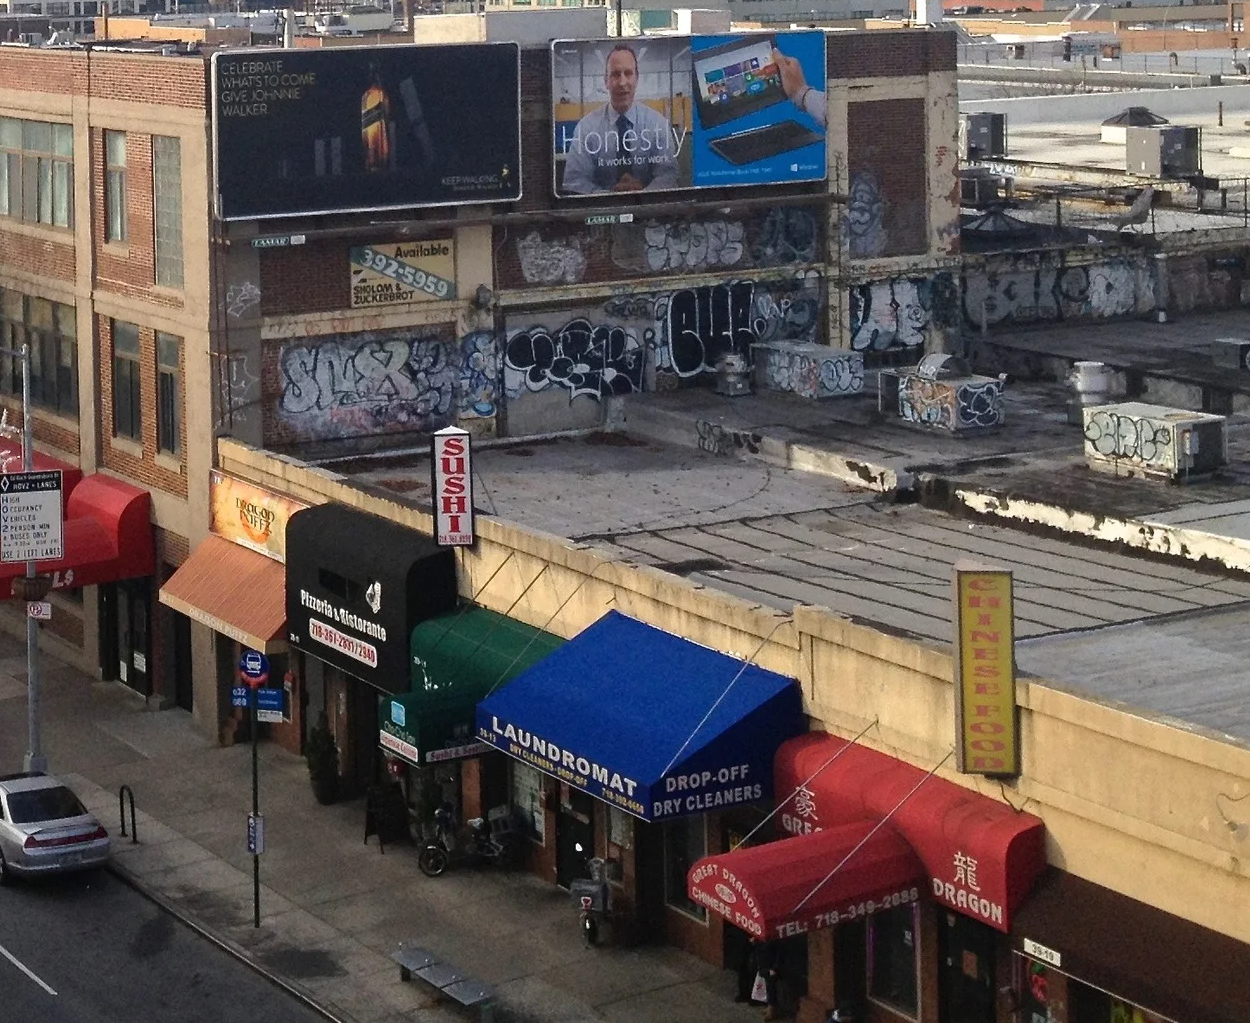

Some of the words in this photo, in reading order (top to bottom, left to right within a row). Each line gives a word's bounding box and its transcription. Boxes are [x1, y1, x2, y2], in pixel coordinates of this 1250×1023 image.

[220, 60, 284, 75] CELEBRATE
[264, 75, 279, 87] TO
[281, 72, 316, 86] COME
[221, 90, 248, 103] GIVE
[250, 87, 301, 101] JOHNNIE
[221, 103, 268, 117] WALKER
[562, 119, 688, 158] Honestly
[597, 157, 605, 167] it
[606, 156, 632, 167] works
[633, 155, 646, 165] for
[587, 215, 615, 224] LAMAR
[394, 243, 450, 258] Available
[359, 249, 448, 297] 392-5959
[353, 283, 393, 295] SHOLOM
[395, 282, 402, 291] &
[353, 290, 415, 305] ZUCKERBROT
[37, 480, 57, 489] LANES
[440, 438, 467, 533] SUSHI
[2, 525, 9, 533] 2
[10, 524, 36, 532] PERSON
[41, 547, 61, 557] LANES
[300, 589, 333, 618] Pizzeria
[340, 607, 387, 642] Ristorante
[967, 578, 1003, 696] CHINESE
[968, 705, 1006, 770] FOOD
[492, 716, 638, 797] LAUNDROMAT
[665, 764, 749, 793] DROP-OFF
[653, 798, 682, 817] DRY
[685, 783, 762, 811] CLEANERS
[952, 850, 981, 892] 龍
[692, 863, 719, 884] GREAT
[722, 868, 760, 919] DRAGON
[932, 877, 1003, 925] DRAGON
[692, 886, 732, 919] CHINESE
[735, 911, 762, 936] FOOD
[775, 920, 808, 939] TEL:
